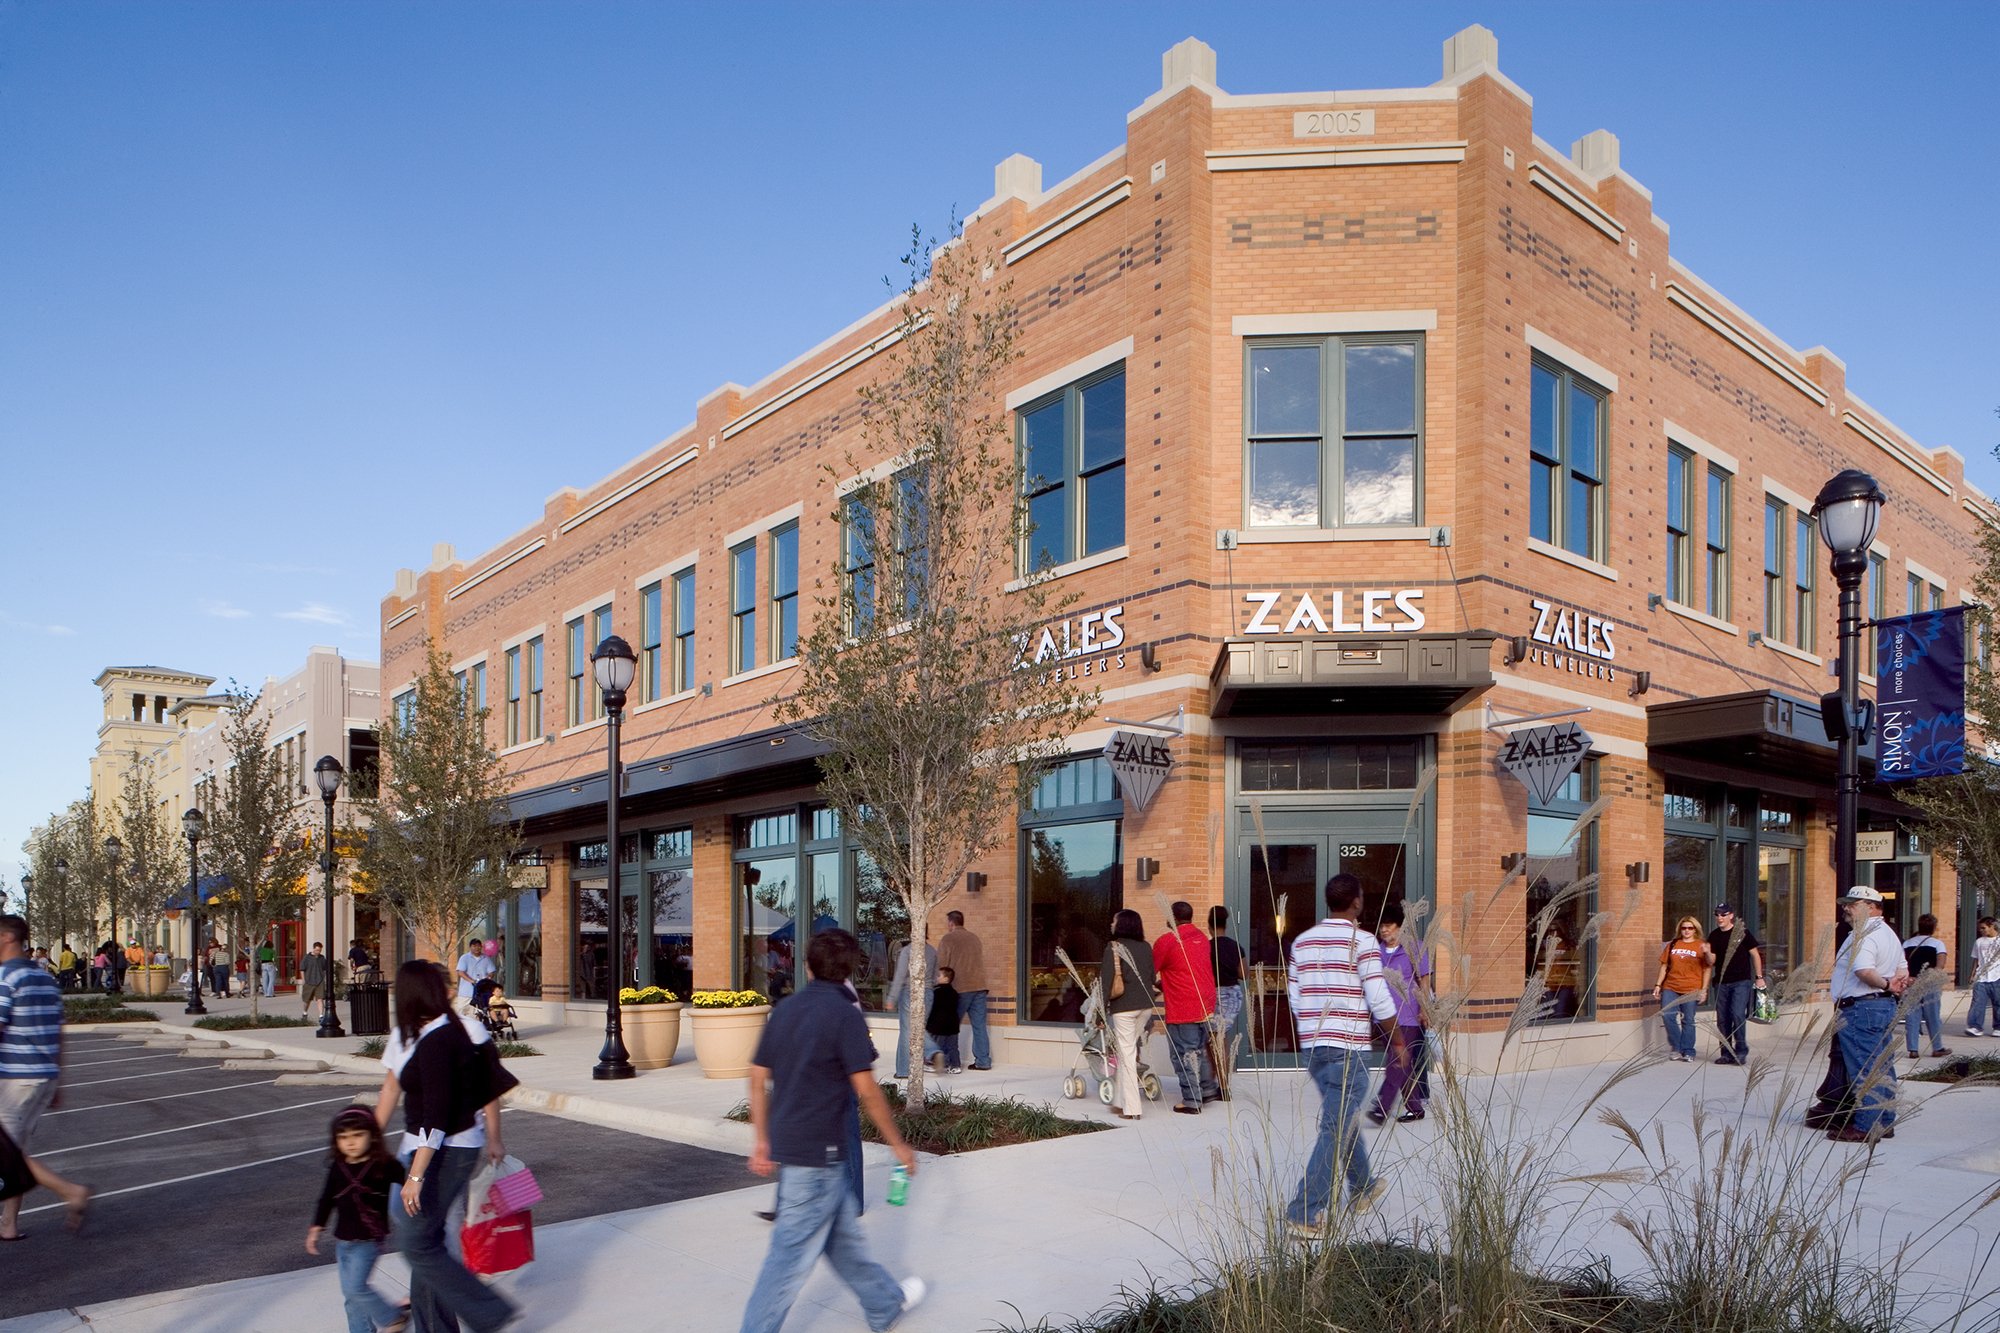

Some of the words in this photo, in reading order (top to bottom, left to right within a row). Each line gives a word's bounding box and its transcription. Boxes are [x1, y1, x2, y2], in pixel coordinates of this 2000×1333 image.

[1307, 112, 1361, 134] 2005
[1244, 590, 1426, 634] ZALES
[1011, 606, 1125, 671] ZALES
[1532, 599, 1615, 660] ZALES
[1530, 648, 1615, 682] JEWELERS
[1893, 633, 1903, 669] choices
[1038, 654, 1125, 686] WELERS
[1894, 670, 1903, 694] more
[1113, 741, 1171, 768] ZALES
[1503, 732, 1582, 763] ZALES
[1883, 711, 1902, 771] SIMON
[1903, 710, 1912, 769] MALLS
[1116, 764, 1167, 776] JEWELERS
[1509, 755, 1577, 771] JEWELERS
[1340, 845, 1366, 857] 325
[1857, 838, 1889, 847] TORIA'S
